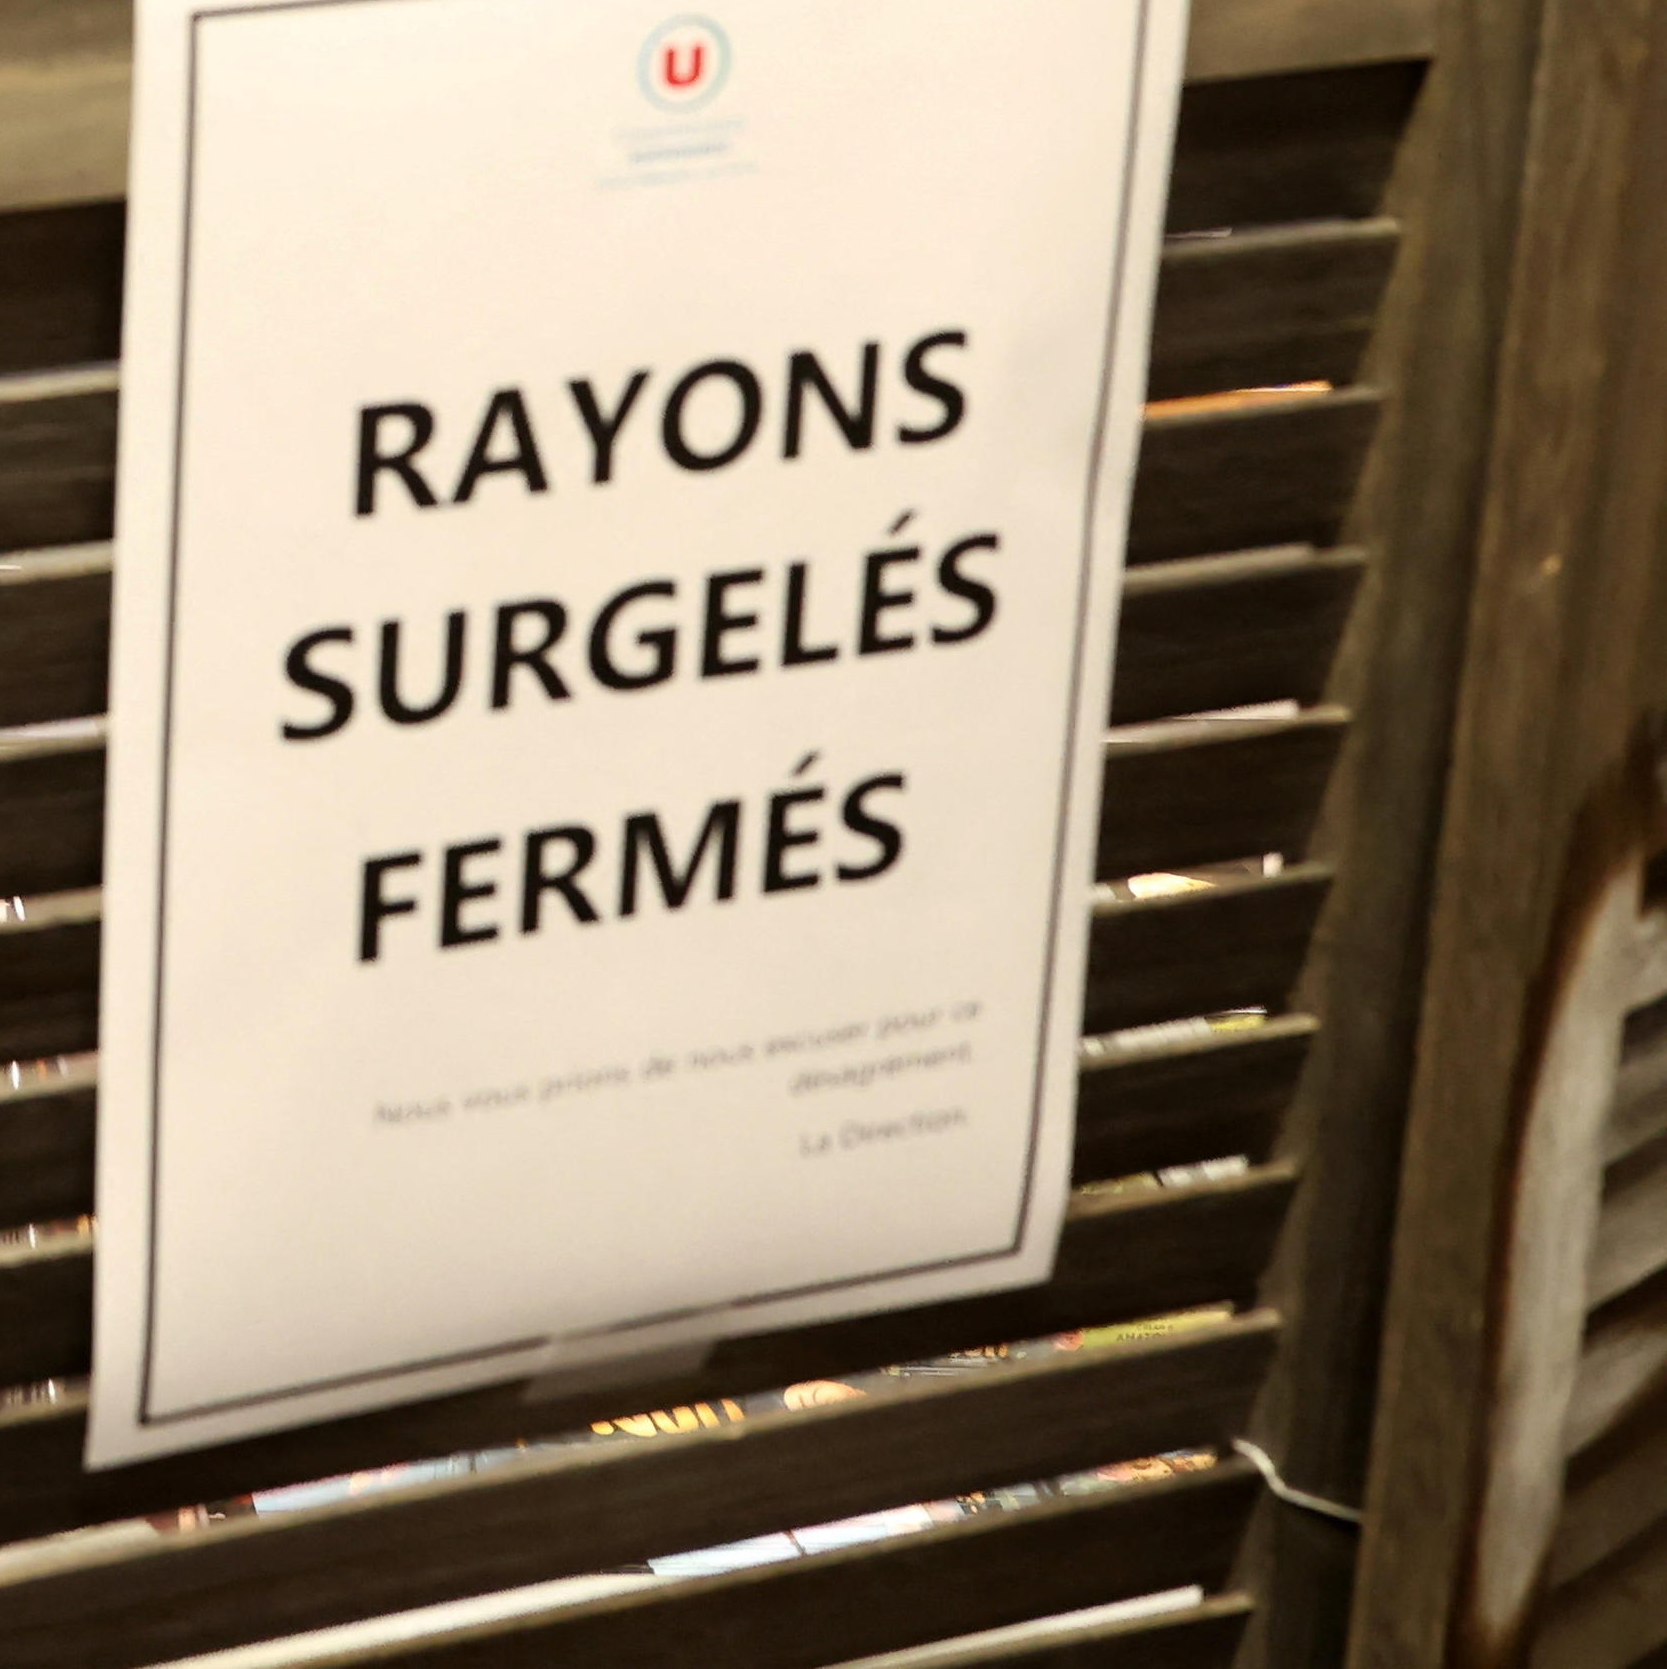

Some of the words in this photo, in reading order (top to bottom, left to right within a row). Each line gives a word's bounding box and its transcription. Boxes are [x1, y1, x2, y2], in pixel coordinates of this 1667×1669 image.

[663, 43, 704, 88] U
[352, 329, 970, 517] RAYONS
[280, 508, 1002, 743] SURGELÉS
[357, 752, 907, 964] FERMÉS
